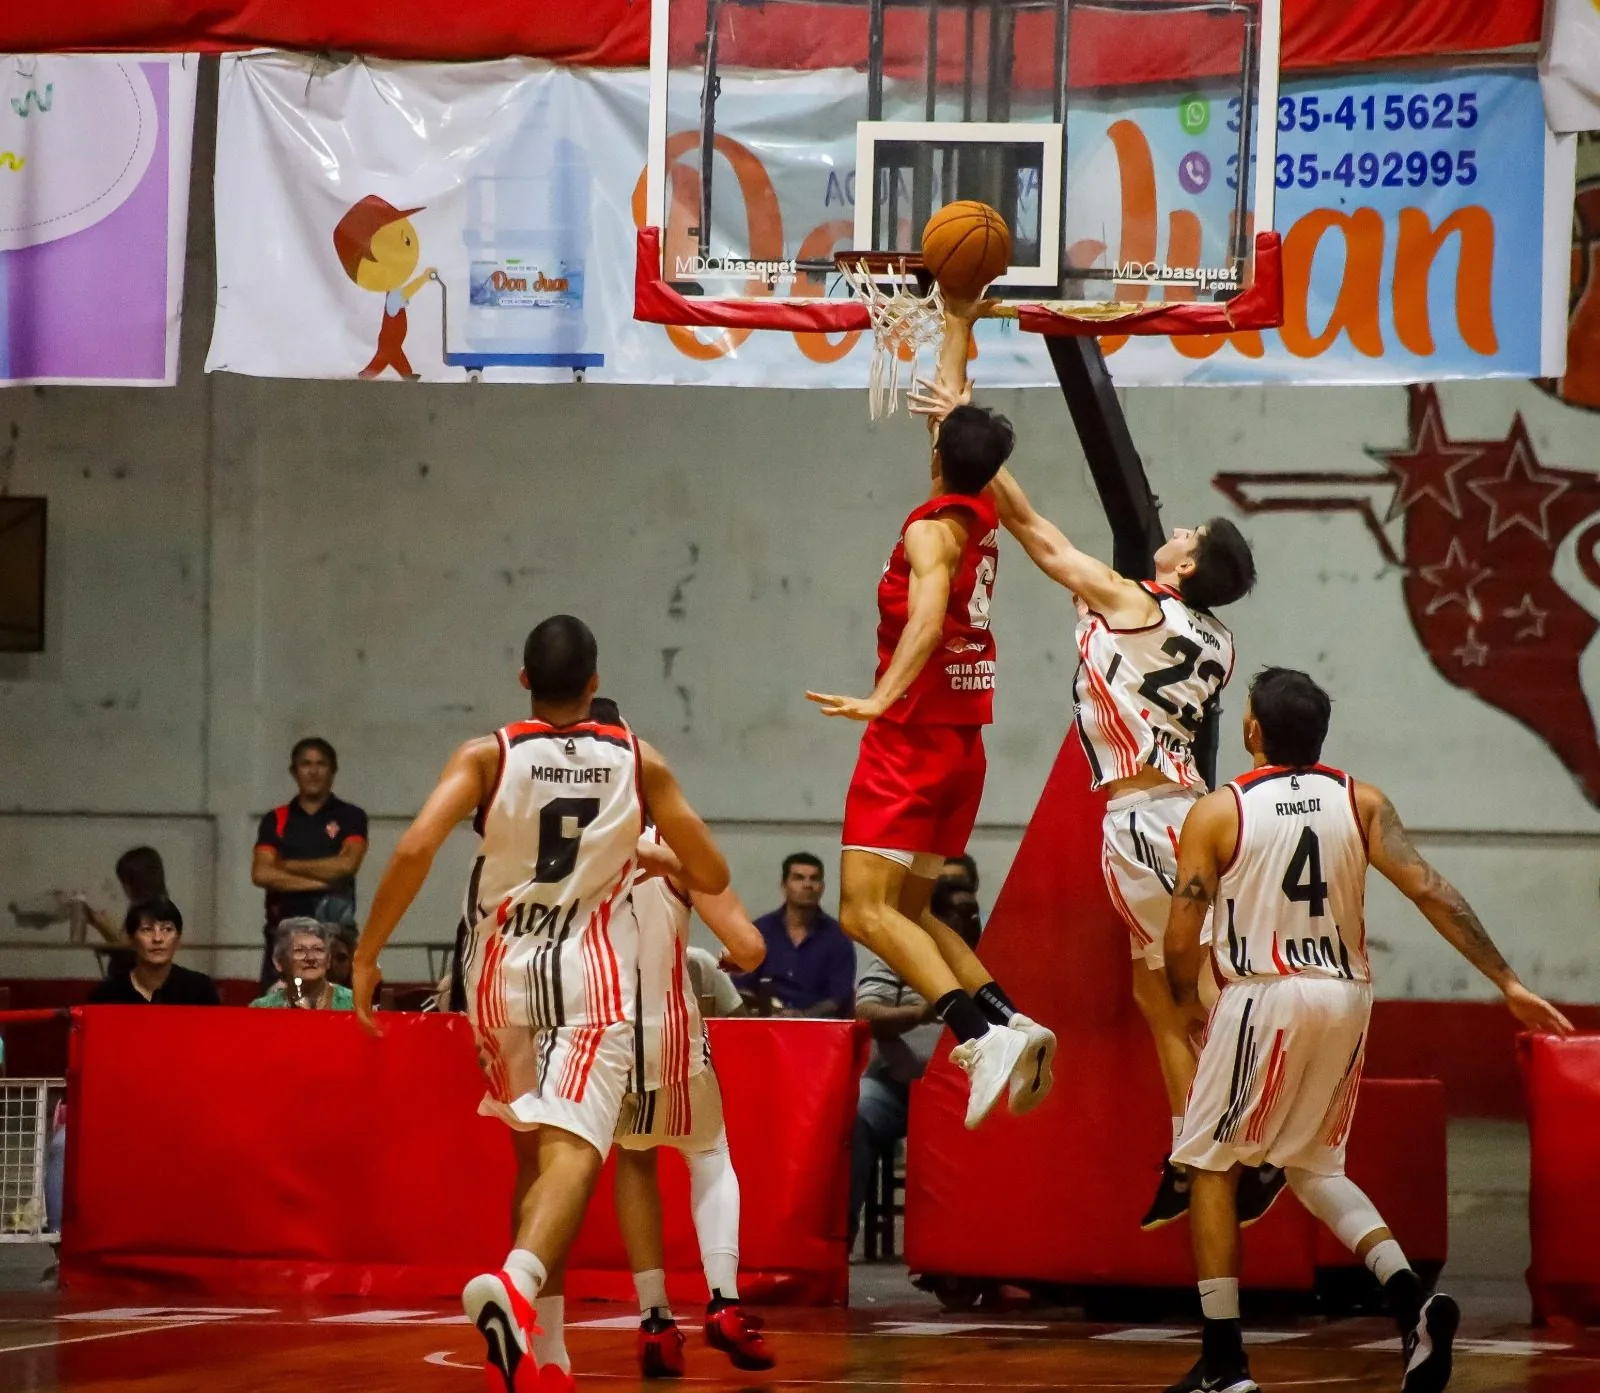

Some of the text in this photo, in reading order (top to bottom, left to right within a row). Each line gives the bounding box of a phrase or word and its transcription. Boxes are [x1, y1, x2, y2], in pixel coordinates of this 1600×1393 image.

[490, 270, 569, 292] Don Juan
[531, 765, 612, 784] MARTURET
[1275, 798, 1321, 816] RINALDI
[535, 797, 600, 883] 6
[1282, 826, 1328, 917] 4
